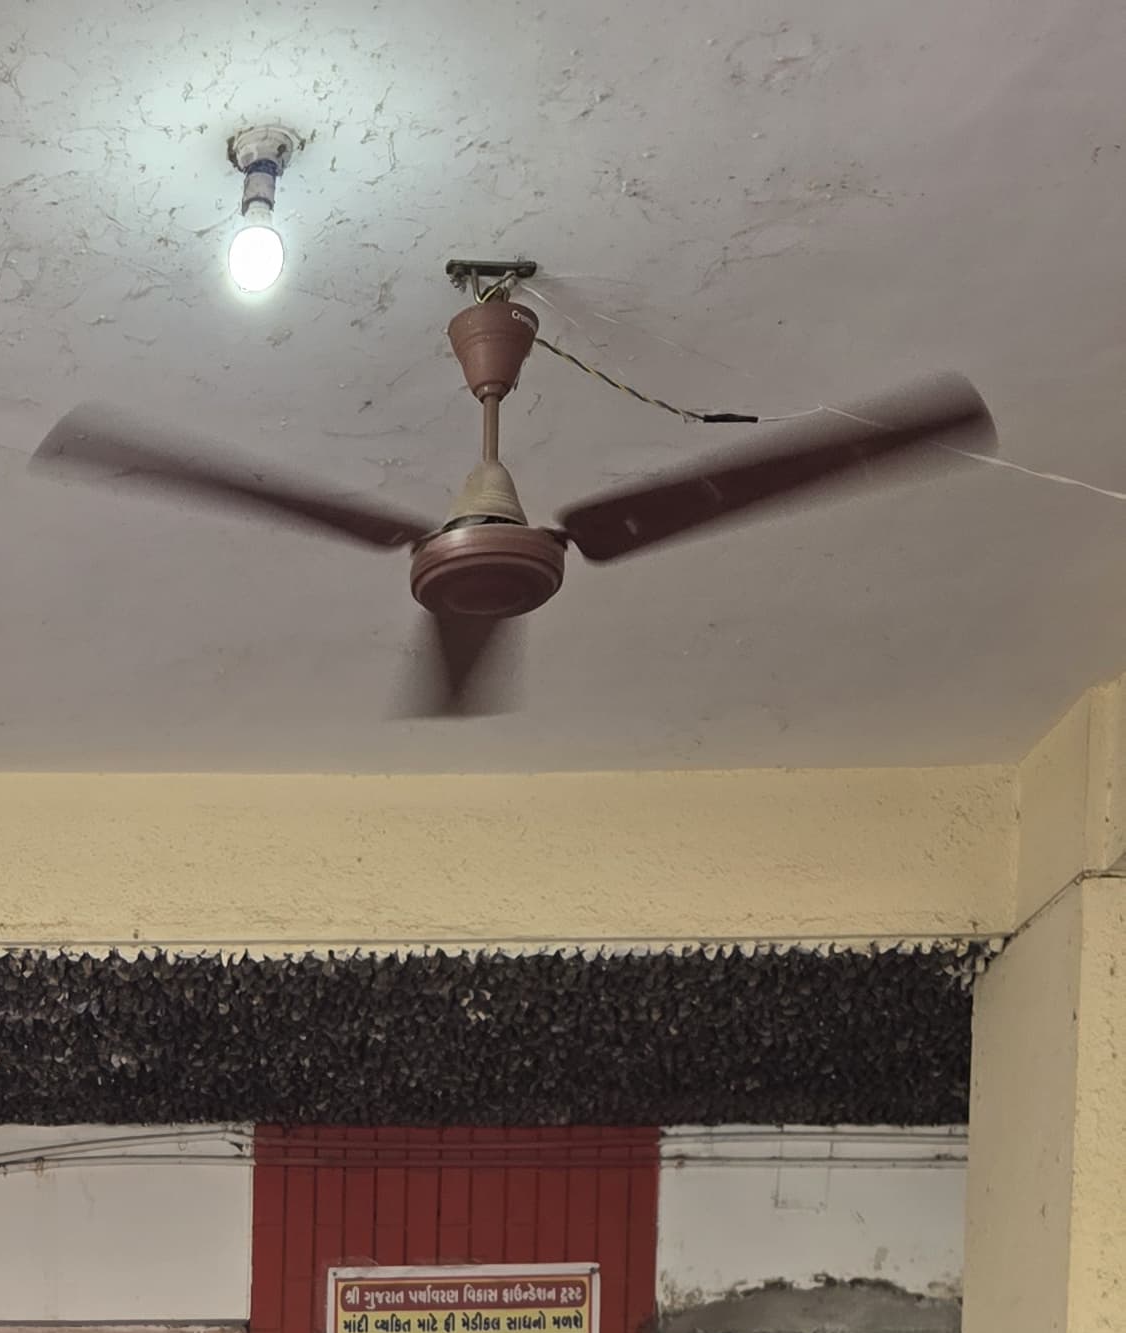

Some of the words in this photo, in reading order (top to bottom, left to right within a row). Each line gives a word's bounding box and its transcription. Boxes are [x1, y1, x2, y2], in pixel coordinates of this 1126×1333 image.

[345, 1286, 360, 1305] શ્રી
[363, 1290, 405, 1310] ગુજરાત
[462, 1283, 498, 1303] વિકાસ
[416, 1312, 439, 1332] માટે
[506, 1310, 547, 1331] સાધનો
[552, 1309, 584, 1330] મળશે
